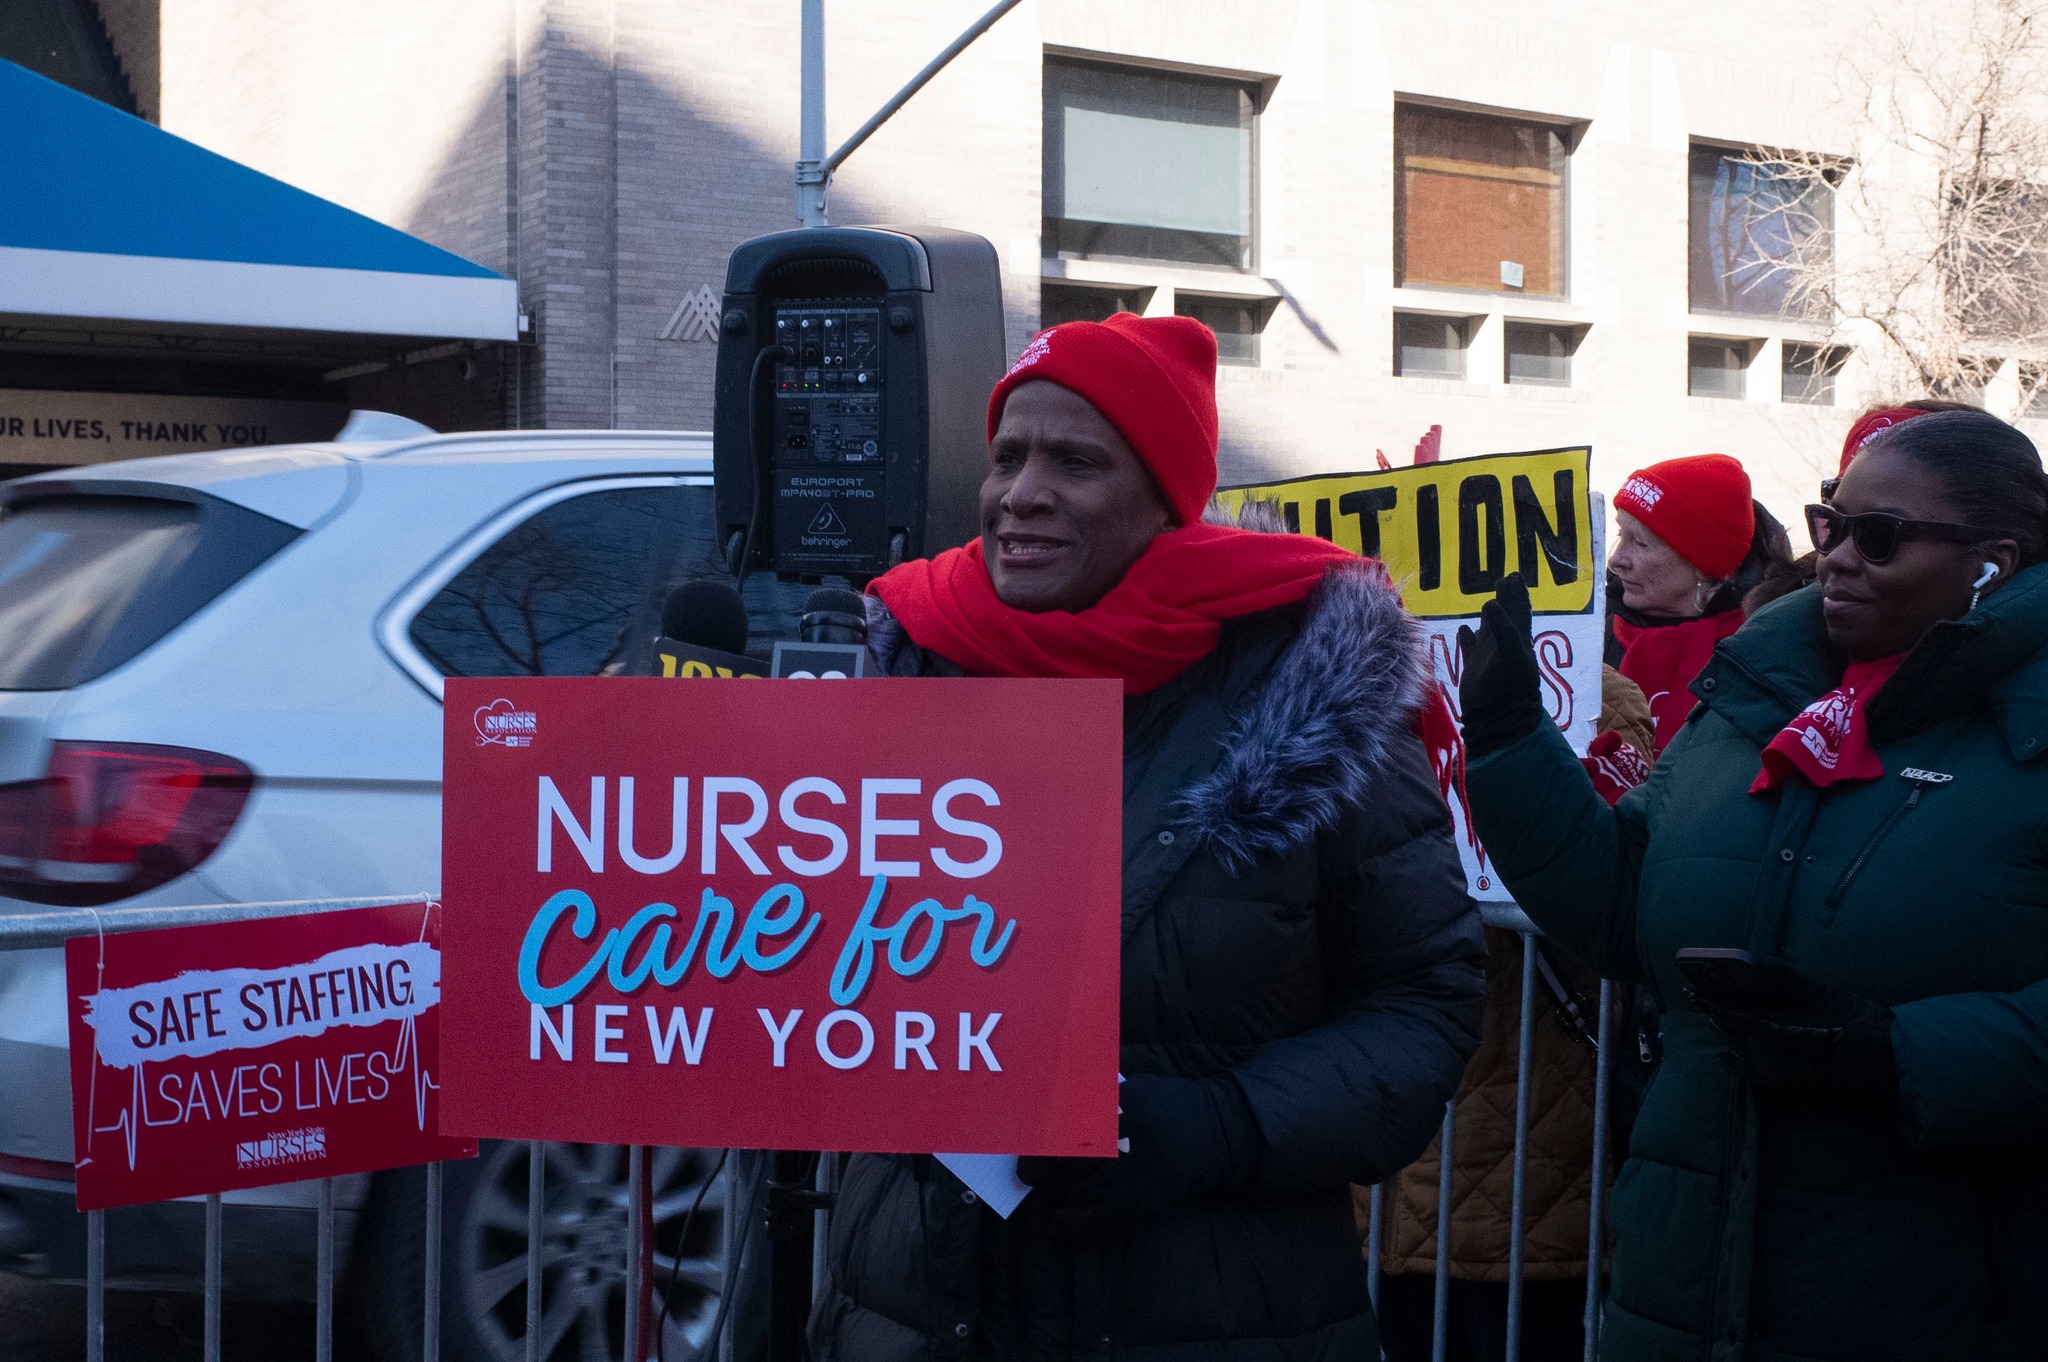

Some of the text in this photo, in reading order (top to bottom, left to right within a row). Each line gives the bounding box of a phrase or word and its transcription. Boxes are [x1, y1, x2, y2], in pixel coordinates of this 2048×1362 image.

[33, 417, 111, 443] LIVES,
[119, 421, 207, 443] THANK
[791, 477, 864, 487] EUROPORT
[801, 535, 852, 548] behringer
[485, 716, 537, 729] NURSES
[537, 775, 1003, 879] NURSES
[517, 872, 1016, 1009] Care for
[129, 959, 415, 1049] SAFE STAFFING
[530, 1003, 1003, 1072] NEW YORK
[158, 1051, 389, 1125] SAVES LIVES
[267, 1126, 325, 1141] New York State
[236, 1133, 325, 1163] NURSES
[237, 1149, 327, 1170] ASSOCIATION
